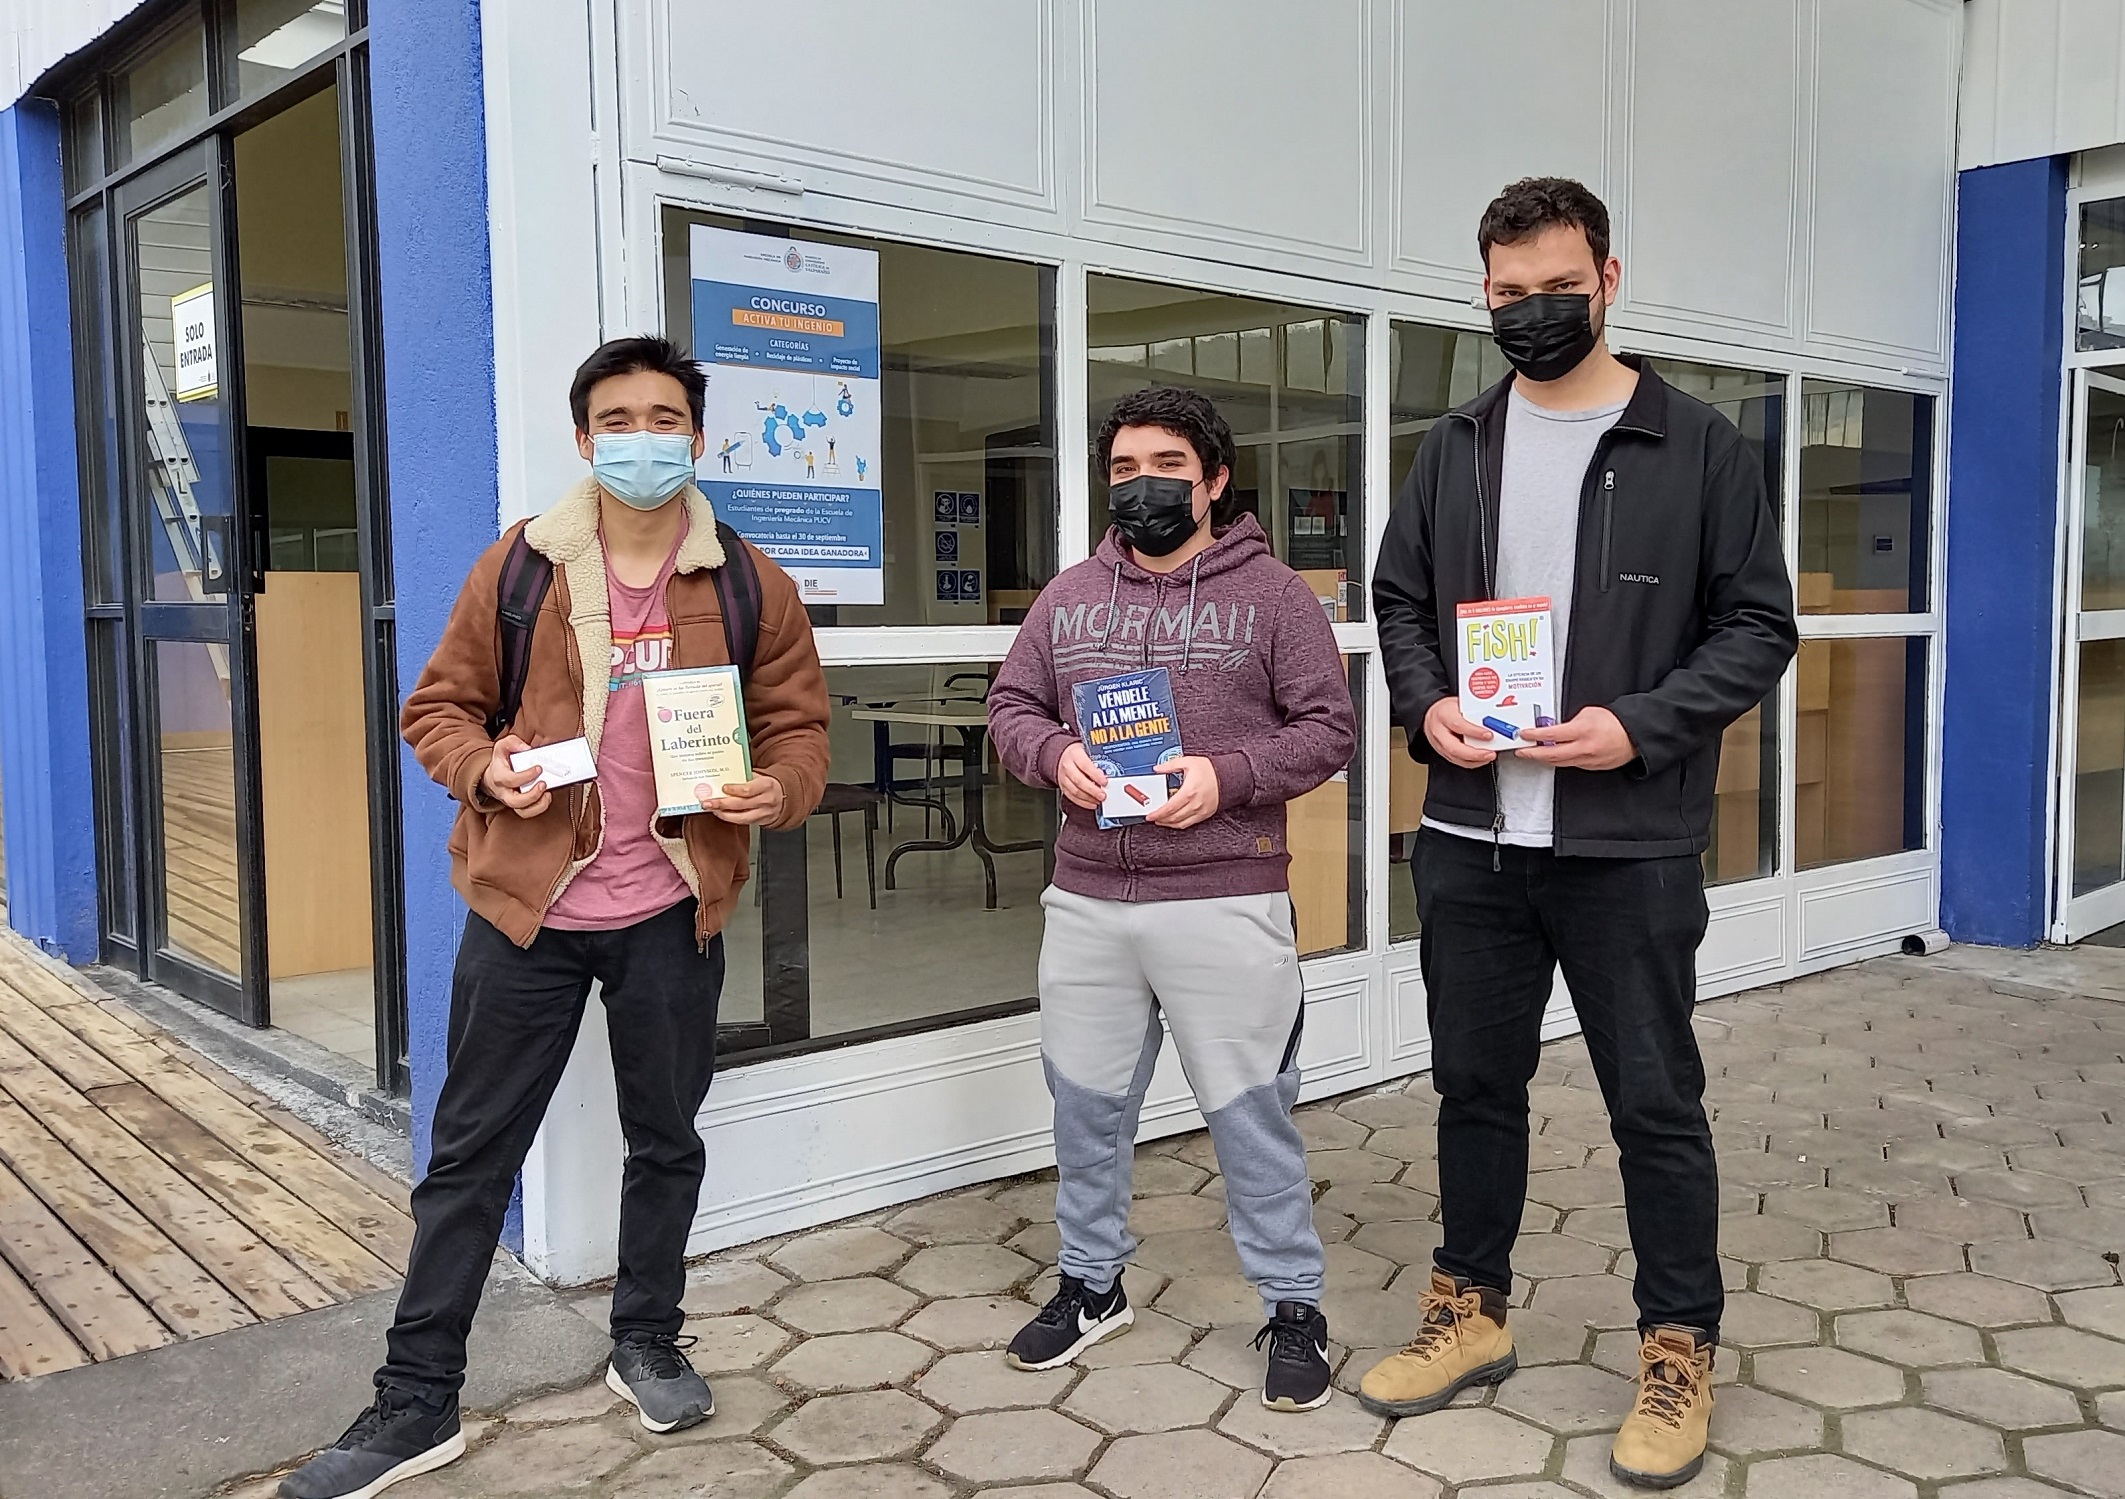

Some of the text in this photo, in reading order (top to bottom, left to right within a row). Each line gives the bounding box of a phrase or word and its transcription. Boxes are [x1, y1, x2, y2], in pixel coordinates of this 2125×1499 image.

[751, 297, 826, 317] CONCURSO
[743, 313, 833, 332] ACTIVA TU INGENIO
[185, 321, 204, 343] SOLO
[770, 339, 809, 351] CATEGORÍAS
[180, 343, 212, 368] ENTRADA
[732, 488, 850, 502] ¿QUIÉNES PUEDEN PARTICIPAR?
[728, 504, 763, 512] Estudiantes
[774, 507, 804, 515] pregrado
[752, 515, 782, 523] Ingeniería
[737, 531, 774, 539] Convocatoria
[775, 532, 790, 540] hasta
[792, 532, 797, 540] el
[815, 533, 847, 543] septiembre
[778, 547, 800, 555] CADA
[820, 549, 864, 557] GANADORA
[804, 579, 818, 587] DIE
[1619, 573, 1659, 584] NAUTICA
[1097, 683, 1121, 692] JÜRGEN
[1098, 686, 1150, 709] VÉNDELE
[674, 709, 714, 721] Fuera
[1092, 702, 1164, 728] A LA MENTE,
[686, 724, 702, 734] del
[1090, 717, 1172, 745] NO A LA GENTE
[661, 735, 731, 751] Laberinto
